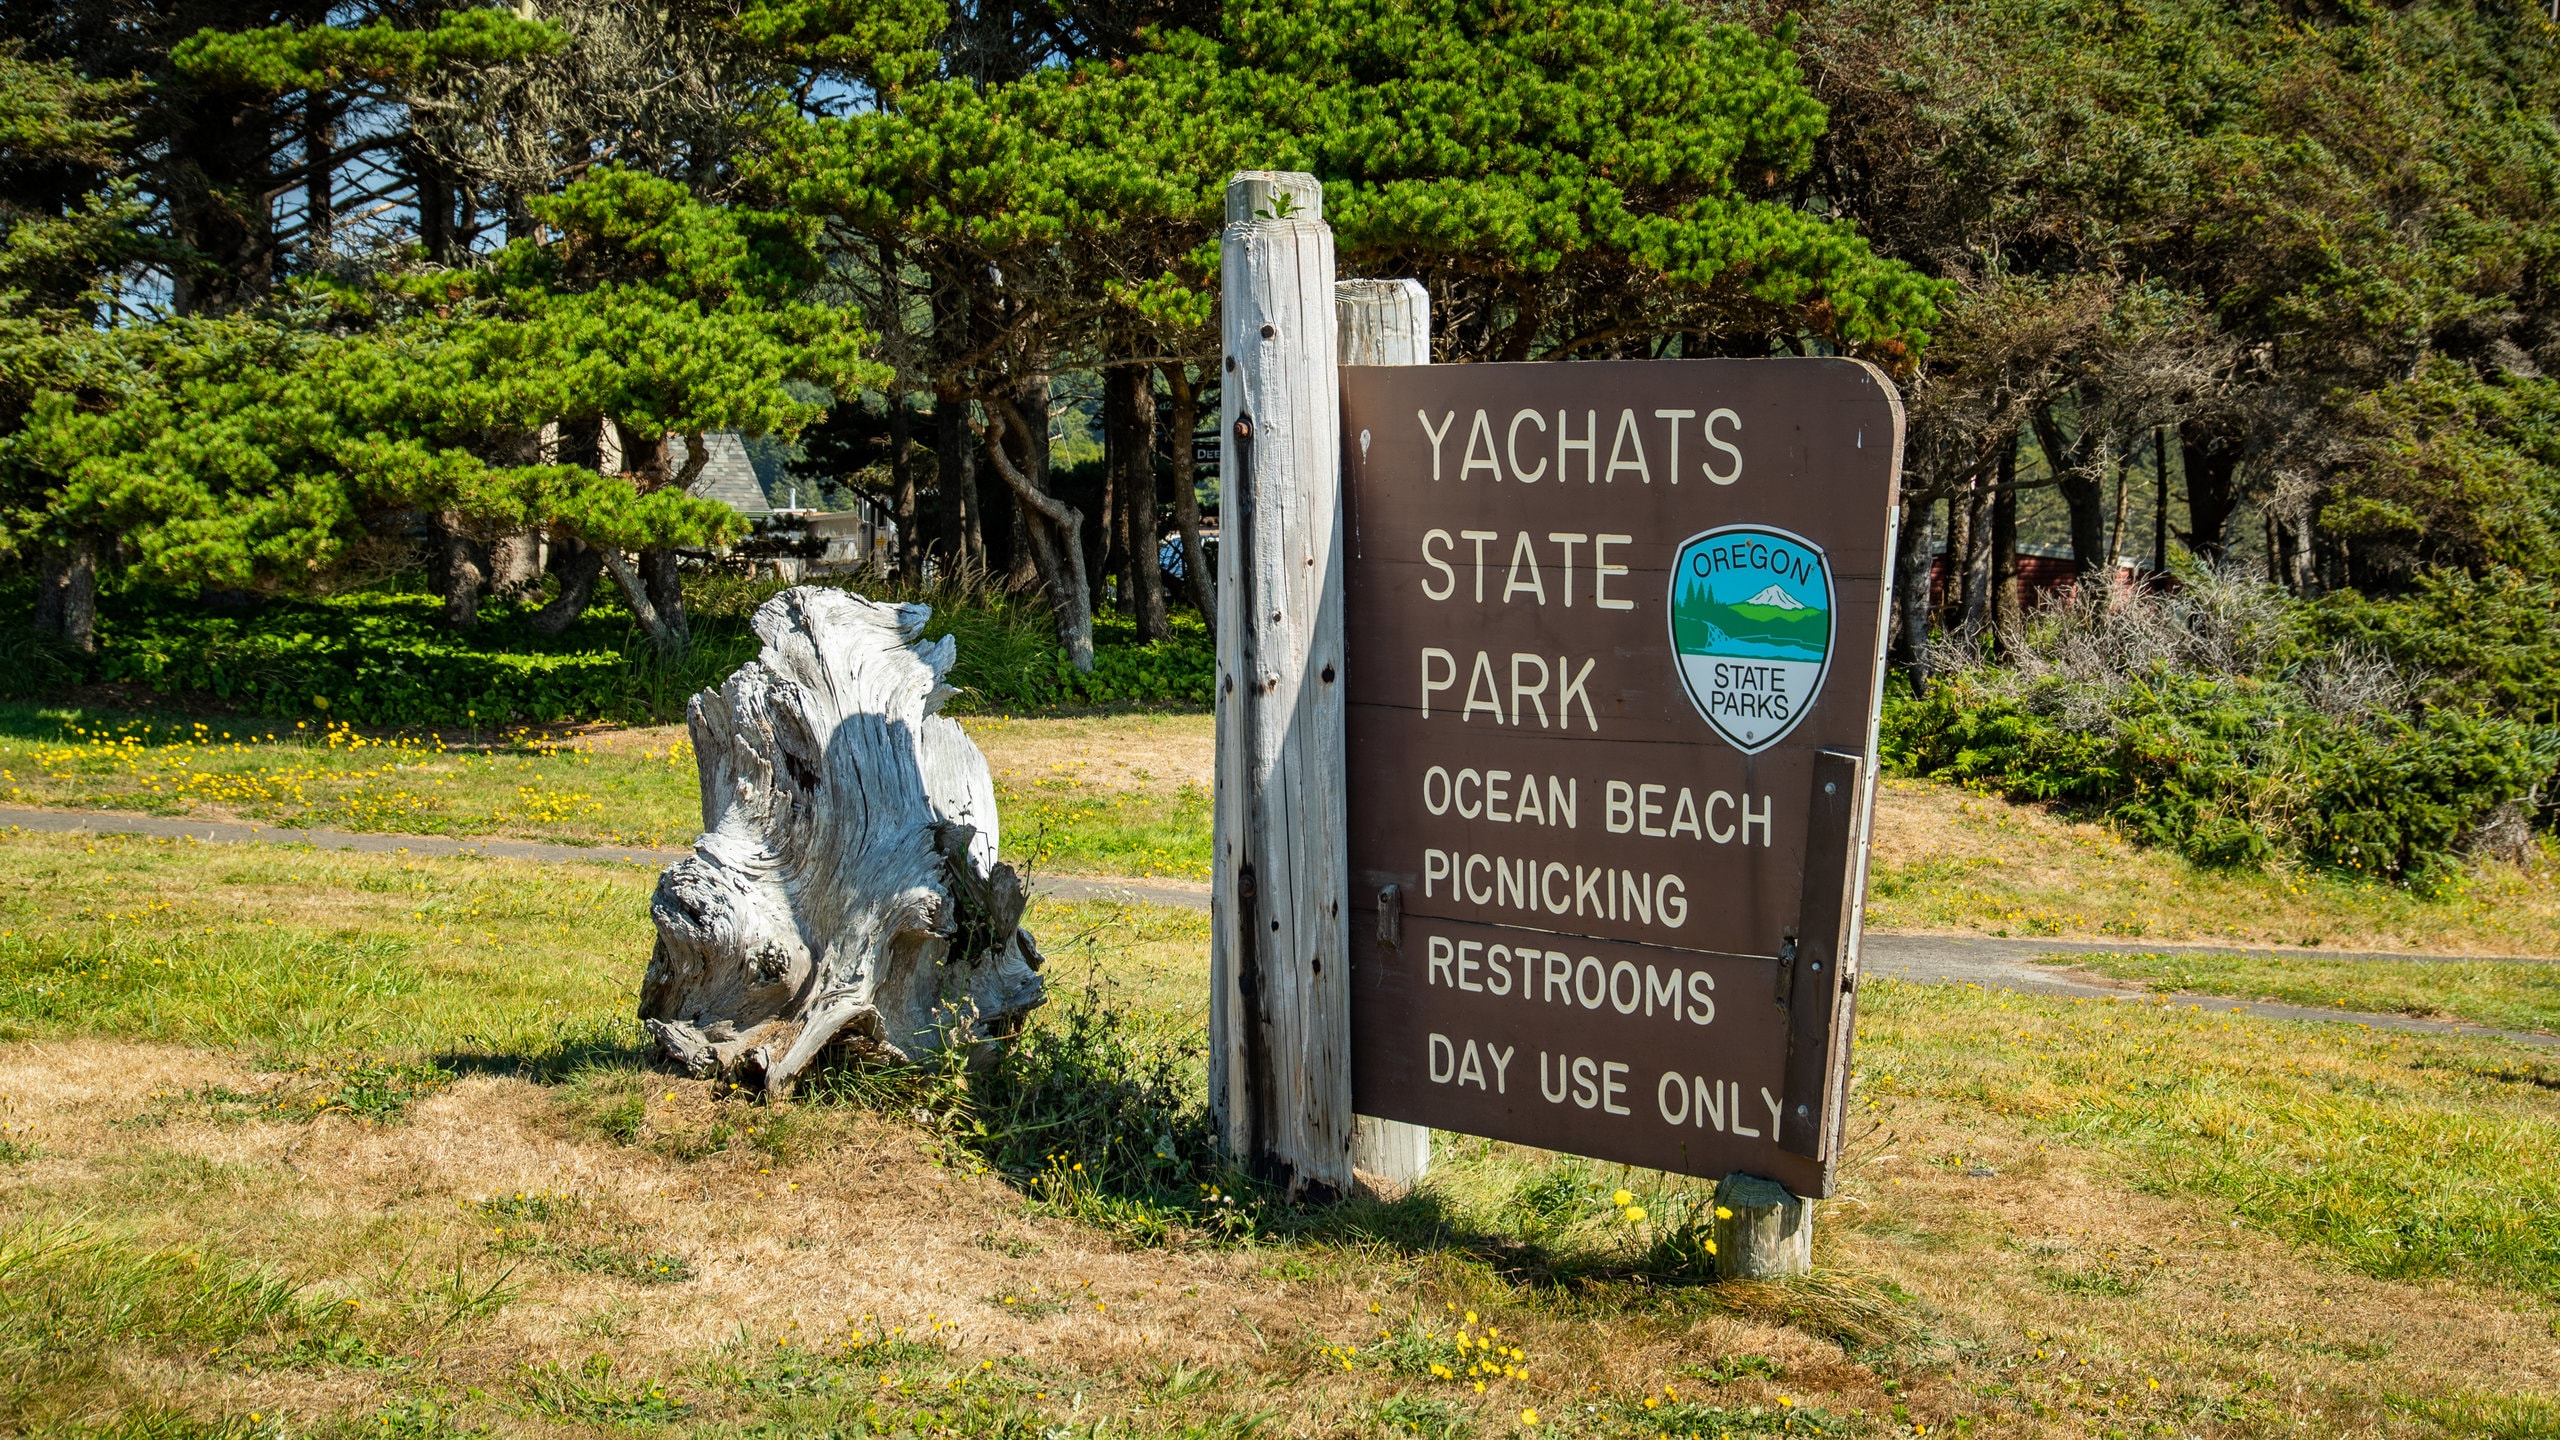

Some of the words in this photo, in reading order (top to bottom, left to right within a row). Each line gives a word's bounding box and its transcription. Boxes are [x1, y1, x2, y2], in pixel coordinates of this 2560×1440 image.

[1418, 408, 1742, 485] YACHATS
[1422, 529, 1634, 609] STATE
[1693, 543, 1811, 586] OREGON
[1422, 648, 1598, 732] PARK
[1711, 690, 1788, 720] PARKS
[1714, 663, 1785, 692] STATE
[1424, 766, 1576, 828] OCEAN
[1606, 780, 1771, 847] BEACH
[1425, 849, 1687, 928] PICNICKING
[1429, 936, 1714, 1025] RESTROOMS
[1429, 1033, 1514, 1093] DAY
[1541, 1052, 1630, 1115] USE
[1658, 1072, 1782, 1141] ONLY
